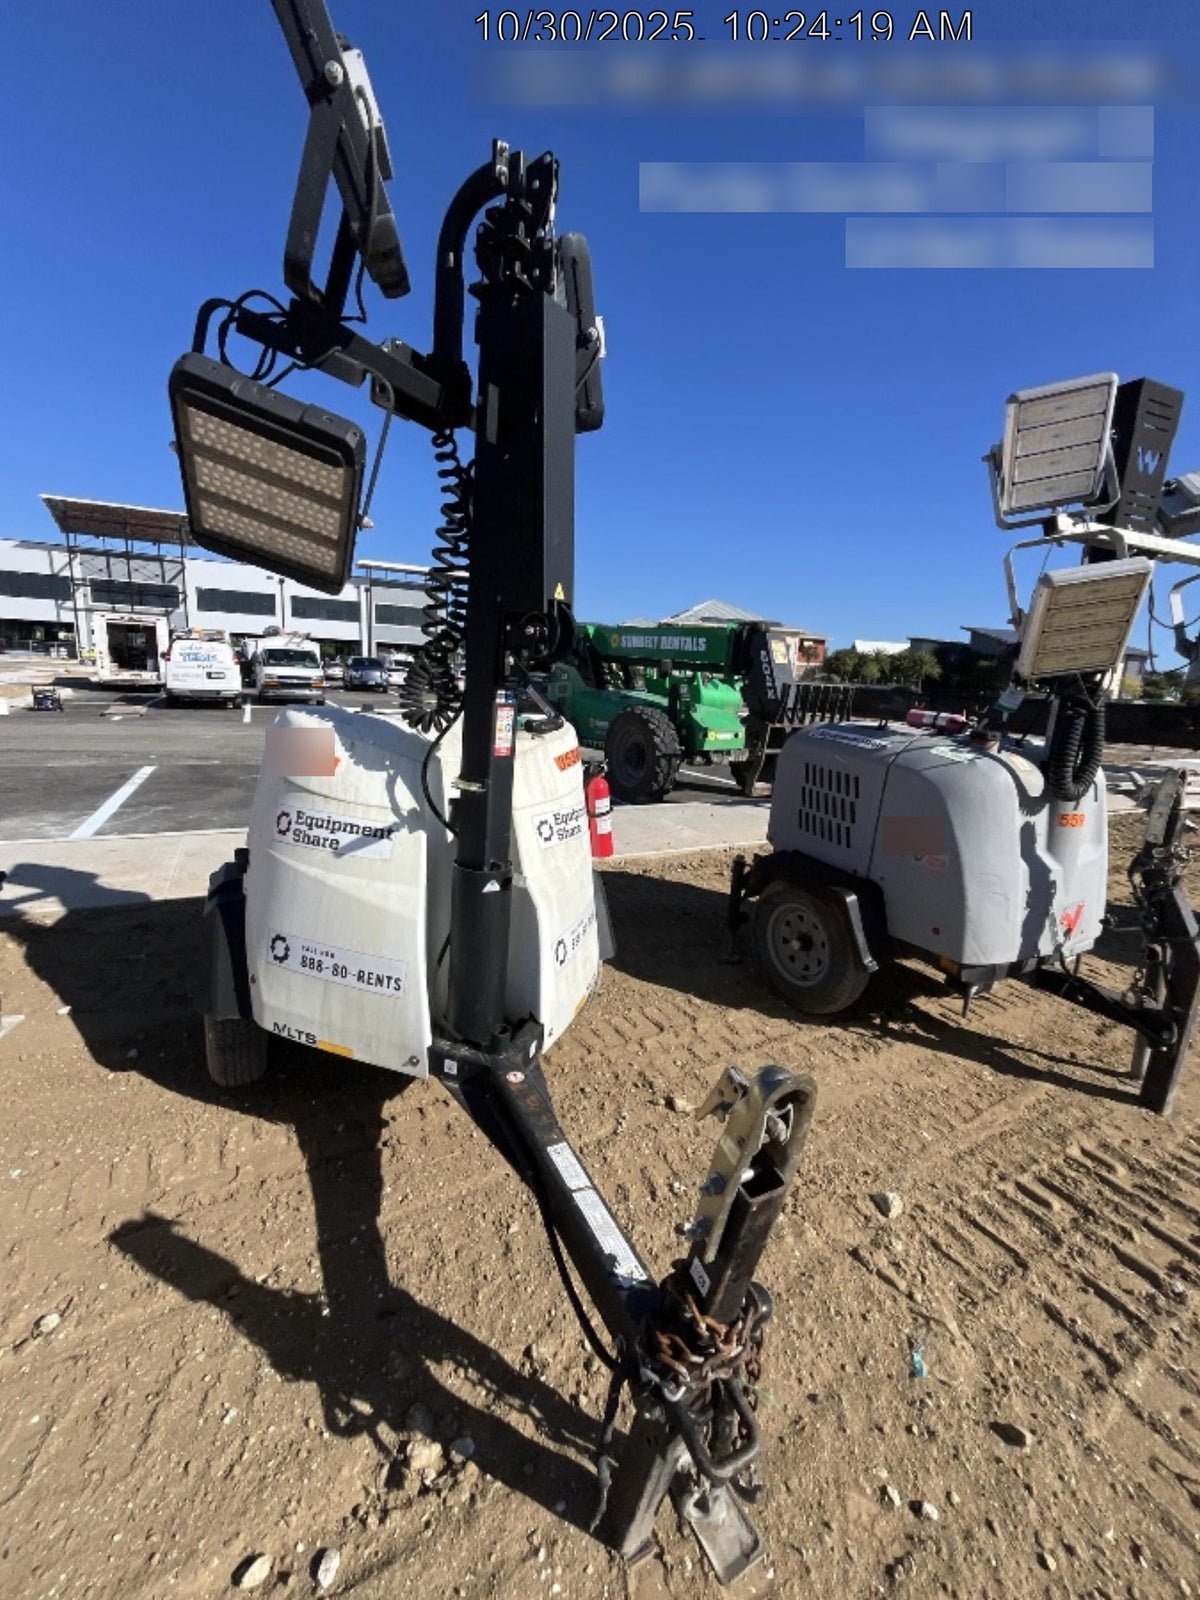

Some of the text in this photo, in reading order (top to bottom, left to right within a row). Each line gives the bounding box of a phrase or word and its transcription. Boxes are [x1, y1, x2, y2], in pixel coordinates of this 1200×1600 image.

[660, 635, 708, 652] RENTALS
[295, 810, 392, 841] Equipment
[293, 828, 340, 850] Share
[300, 955, 403, 991] 888-80-RENTS
